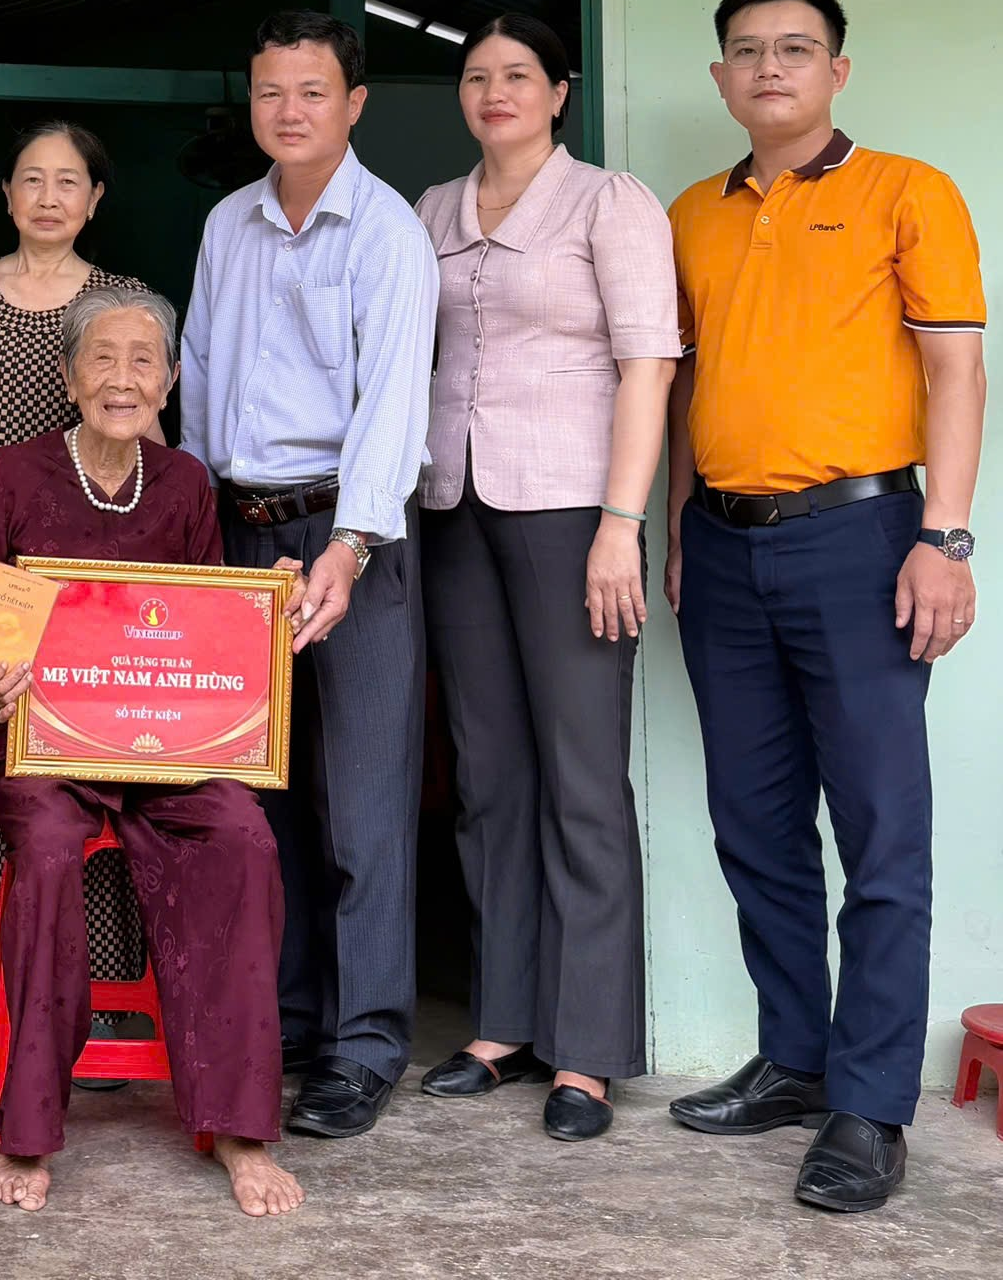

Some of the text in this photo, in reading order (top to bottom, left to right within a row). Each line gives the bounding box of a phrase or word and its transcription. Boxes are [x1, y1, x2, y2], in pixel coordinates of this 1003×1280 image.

[809, 223, 836, 231] LPBank
[111, 654, 193, 668] QUÀ TẶNG TRI ÂN
[42, 665, 244, 691] MẸ VIỆT NAM ANH HÙNG
[115, 704, 181, 722] SỔ TIẾT KIỆM
